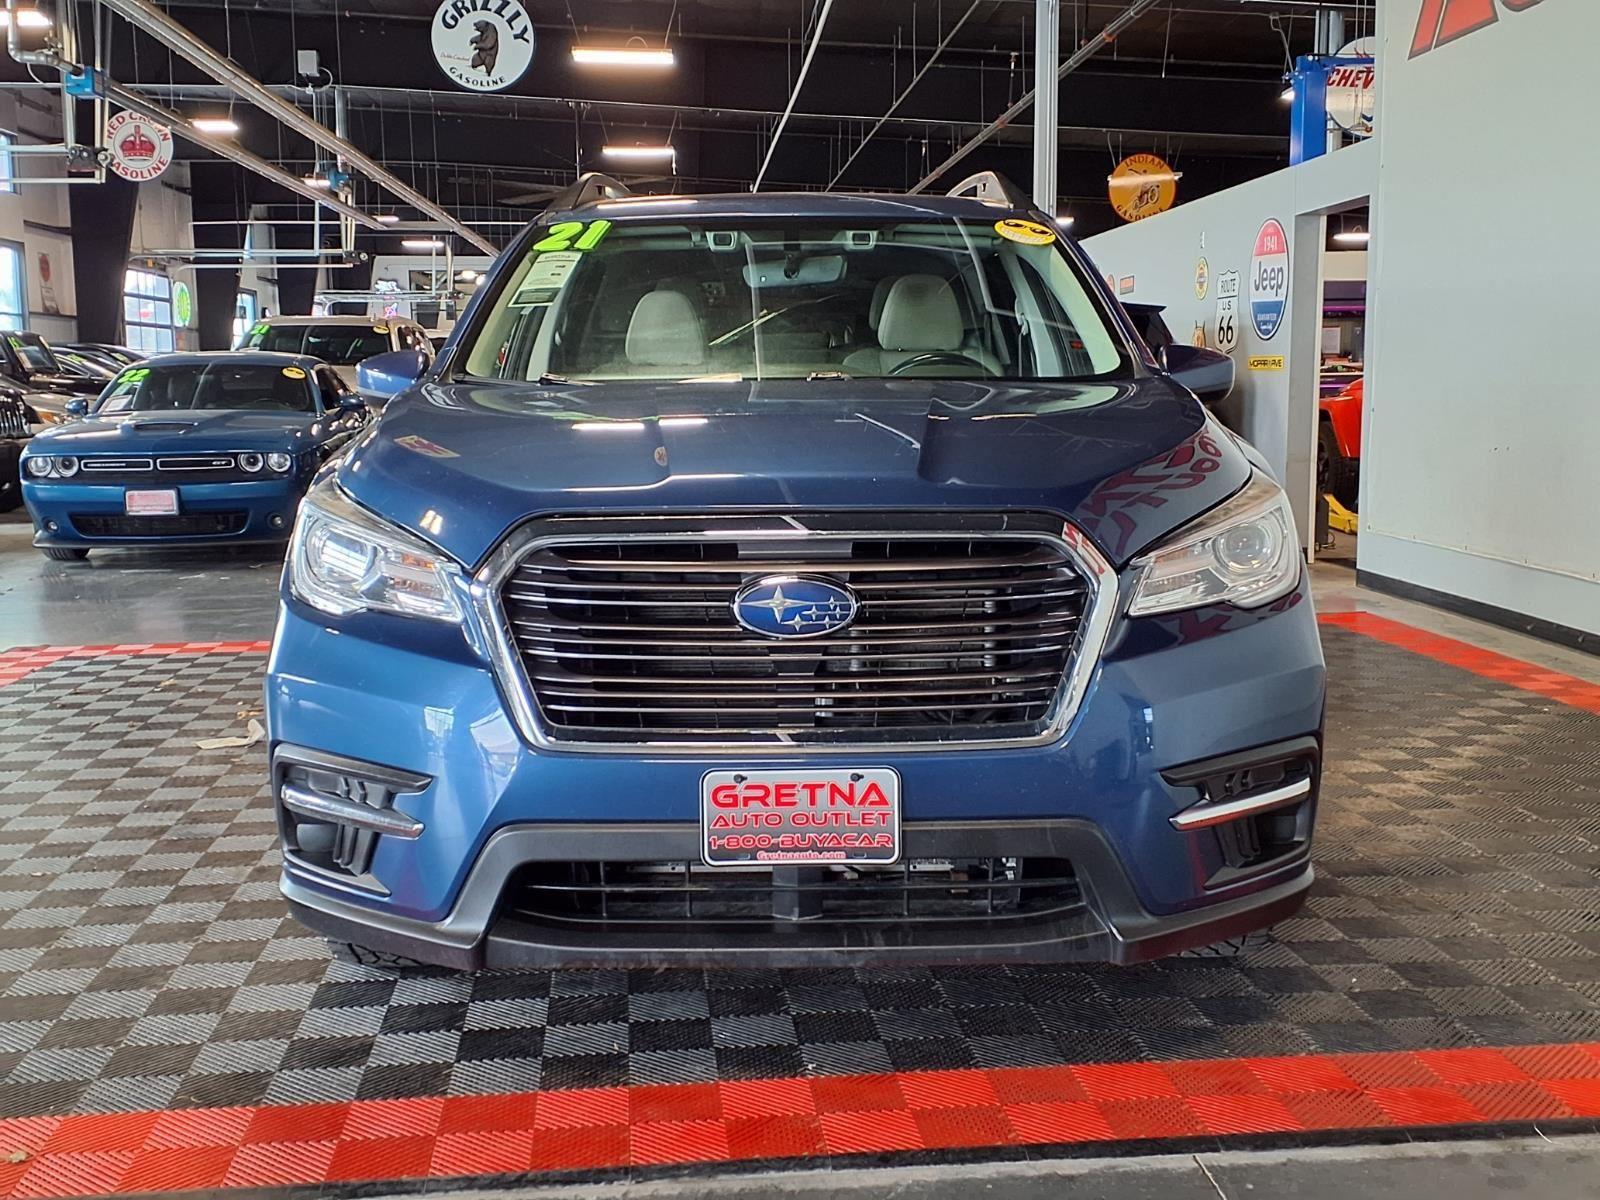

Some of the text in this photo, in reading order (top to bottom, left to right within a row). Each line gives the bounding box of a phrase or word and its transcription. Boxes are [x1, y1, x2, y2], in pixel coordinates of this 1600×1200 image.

[442, 0, 530, 43] GRIZZLY
[449, 67, 506, 87] GASOLINE
[107, 115, 126, 139] RED
[1125, 155, 1165, 170] INDIAN
[533, 220, 612, 252] 21
[1264, 235, 1278, 252] 1941
[1221, 278, 1236, 293] ROUTE
[1254, 261, 1284, 297] Jeep
[1222, 301, 1232, 311] US
[1218, 315, 1234, 344] 66
[117, 368, 150, 383] 22
[711, 781, 891, 809] GRETNA
[710, 811, 893, 828] AUTO OUTLET
[709, 833, 893, 849] 1-800-BUYACAR
